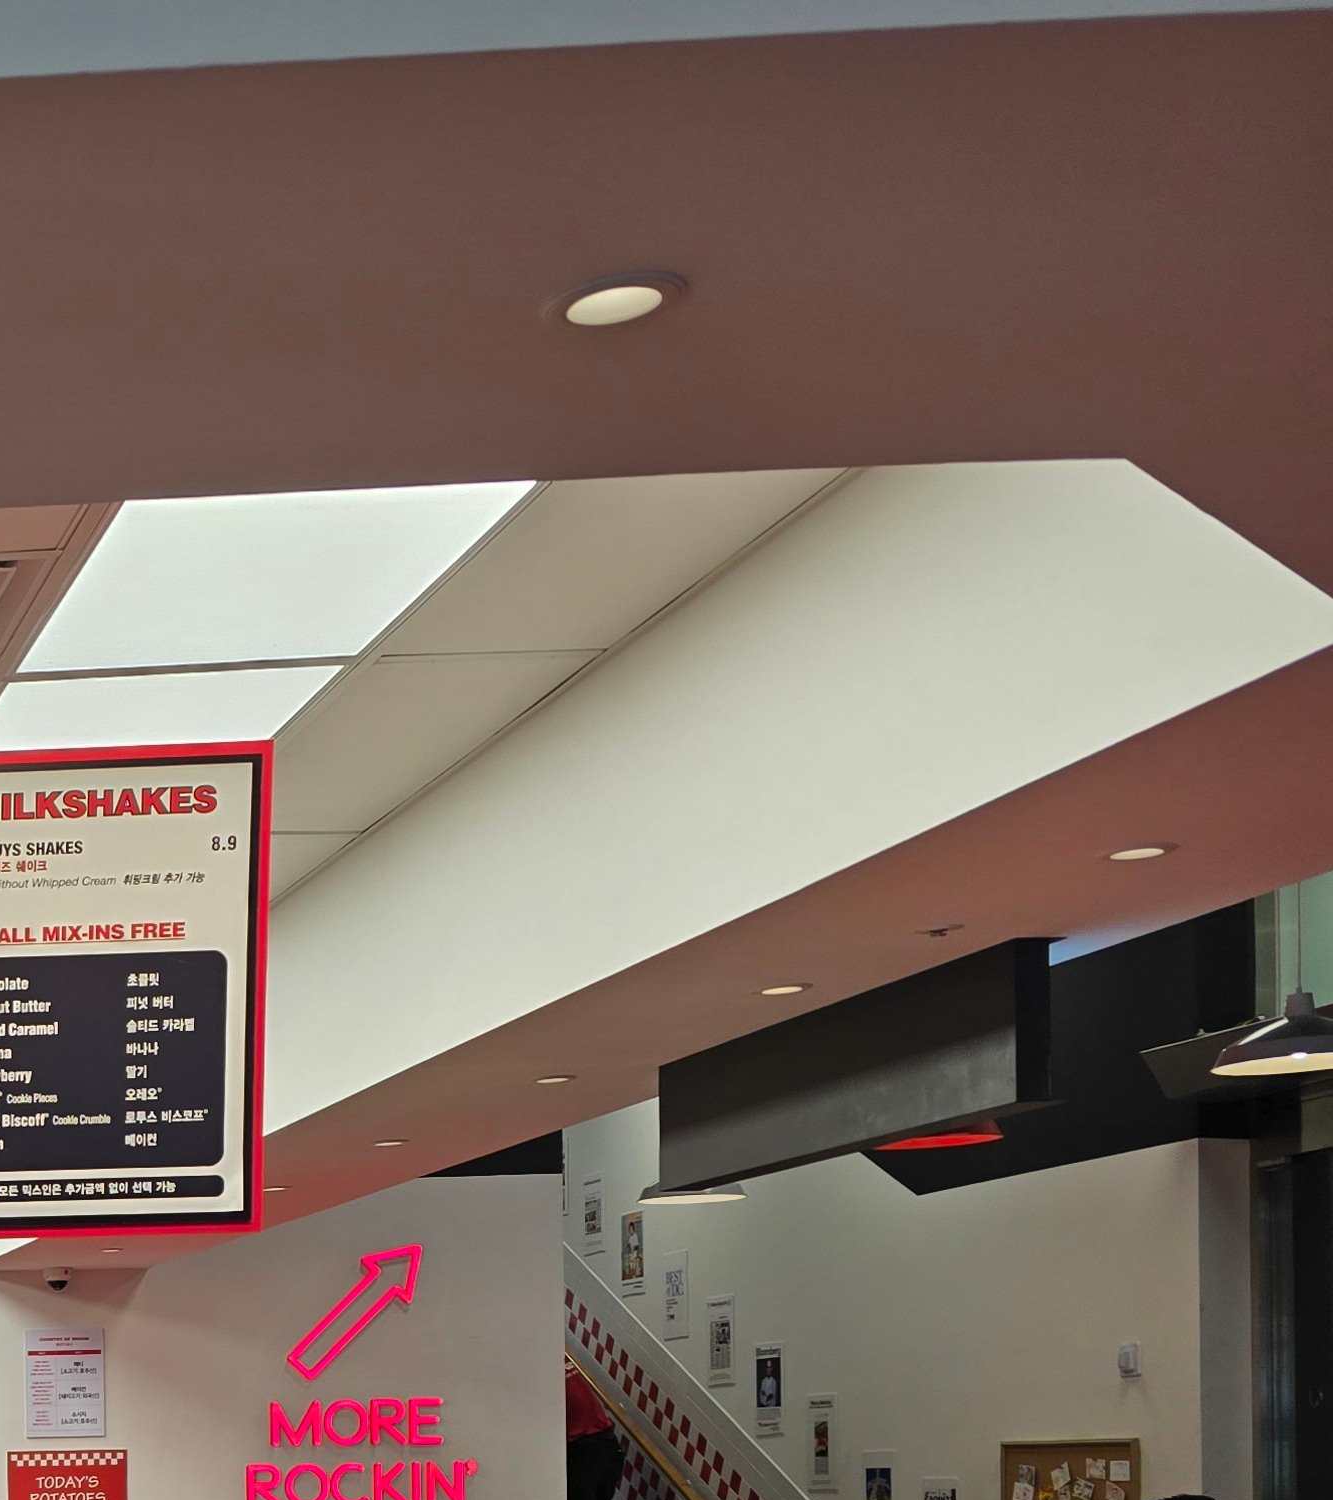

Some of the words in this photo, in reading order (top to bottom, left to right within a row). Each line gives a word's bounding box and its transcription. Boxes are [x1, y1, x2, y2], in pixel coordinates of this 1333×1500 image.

[25, 840, 82, 856] SHAKES
[211, 835, 236, 851] 8.9
[32, 876, 79, 889] Whipped
[81, 875, 116, 886] Cream
[43, 925, 124, 943] MIX-INS
[129, 923, 186, 940] FREE
[269, 1396, 444, 1447] MORE
